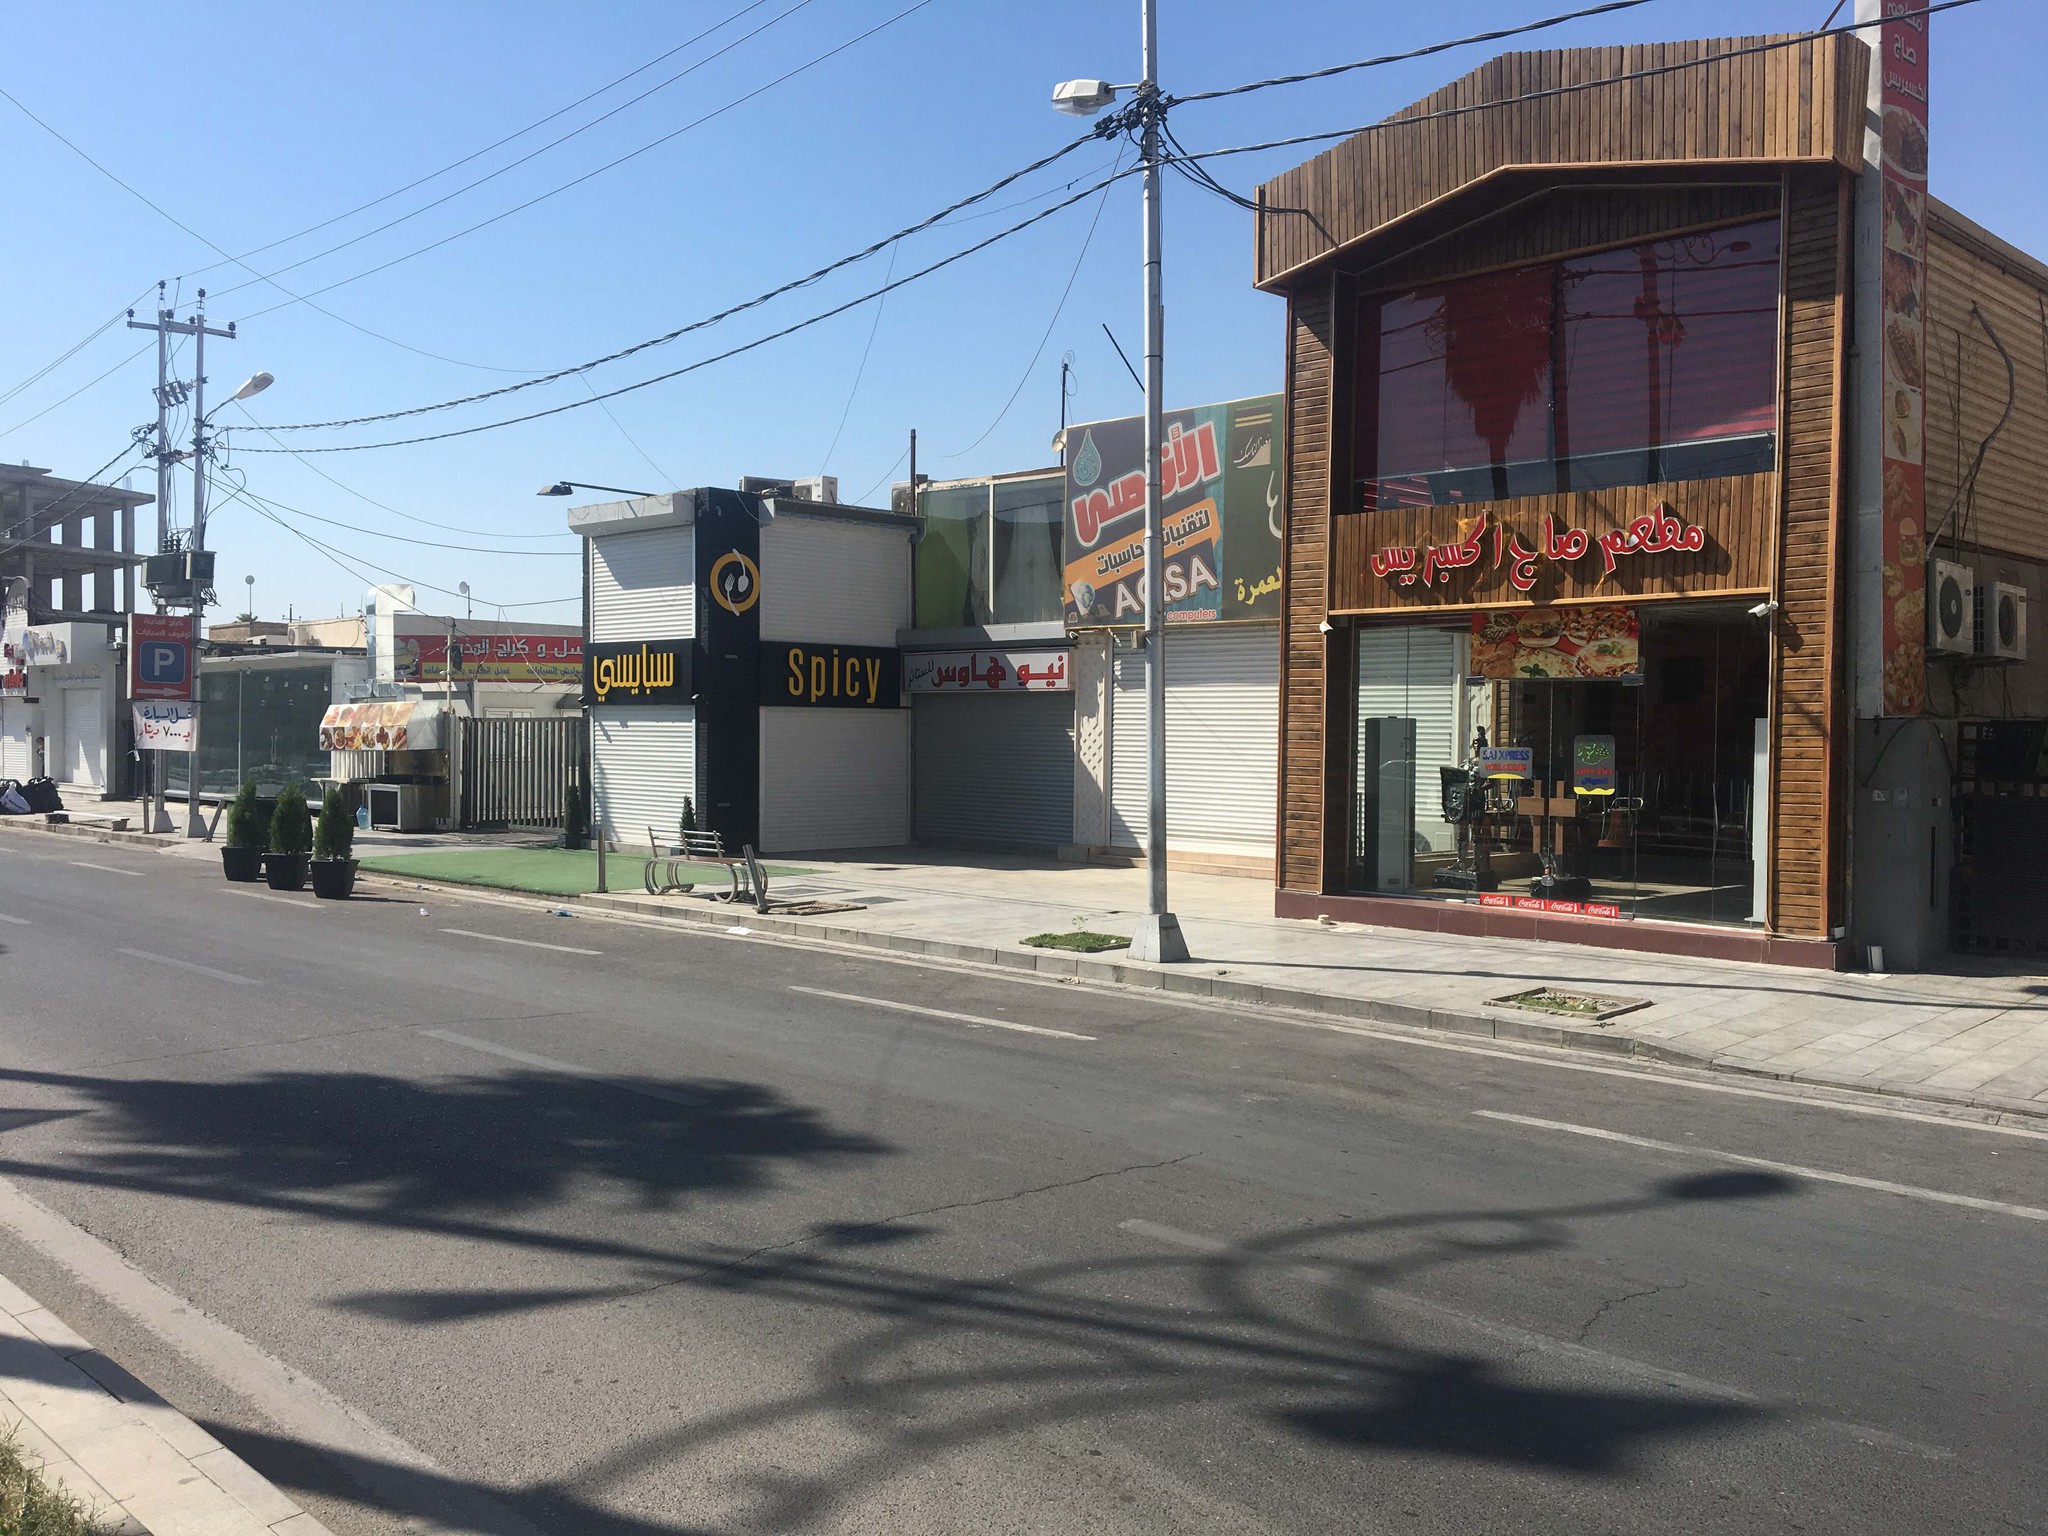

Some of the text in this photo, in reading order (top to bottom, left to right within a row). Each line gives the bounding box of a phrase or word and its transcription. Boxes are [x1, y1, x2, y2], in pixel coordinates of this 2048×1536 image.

[1893, 34, 1917, 65] صاج
[1597, 500, 1705, 574] مطعم
[168, 618, 184, 627] كراج
[1166, 608, 1217, 622] computers
[154, 648, 175, 676] P
[497, 638, 529, 658] كراج
[537, 643, 546, 658] و
[554, 639, 583, 658] سل
[593, 644, 674, 702] سبايسي
[788, 647, 881, 704] Spicy
[931, 653, 1007, 688] هاوس
[1016, 655, 1065, 688] نيو
[139, 722, 160, 739] دينار
